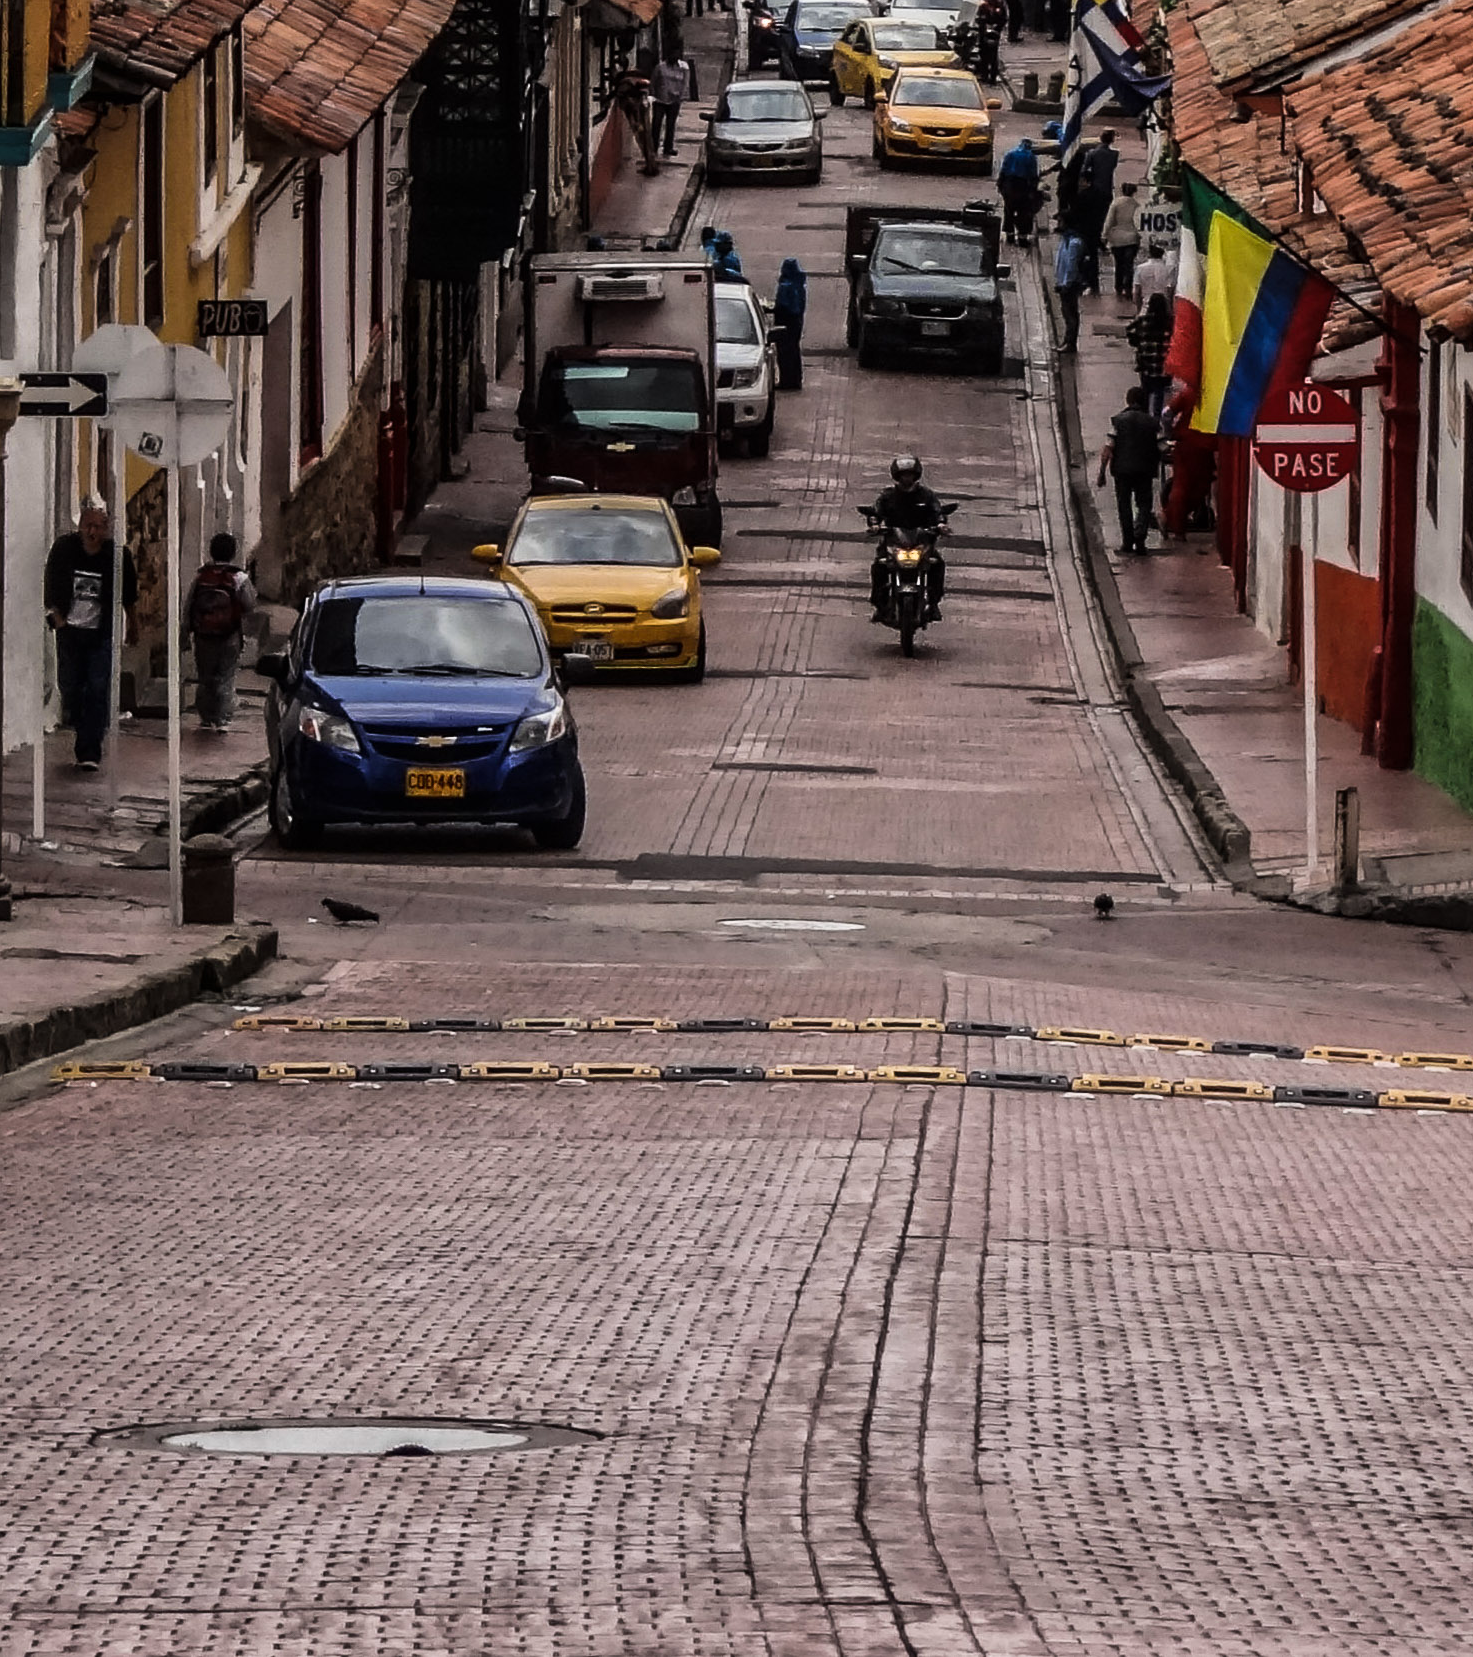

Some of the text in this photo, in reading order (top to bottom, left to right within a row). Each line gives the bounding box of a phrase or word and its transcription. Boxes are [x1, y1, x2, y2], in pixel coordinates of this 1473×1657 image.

[202, 303, 242, 334] PUB
[1289, 390, 1322, 415] NO
[1274, 452, 1340, 477] PASE
